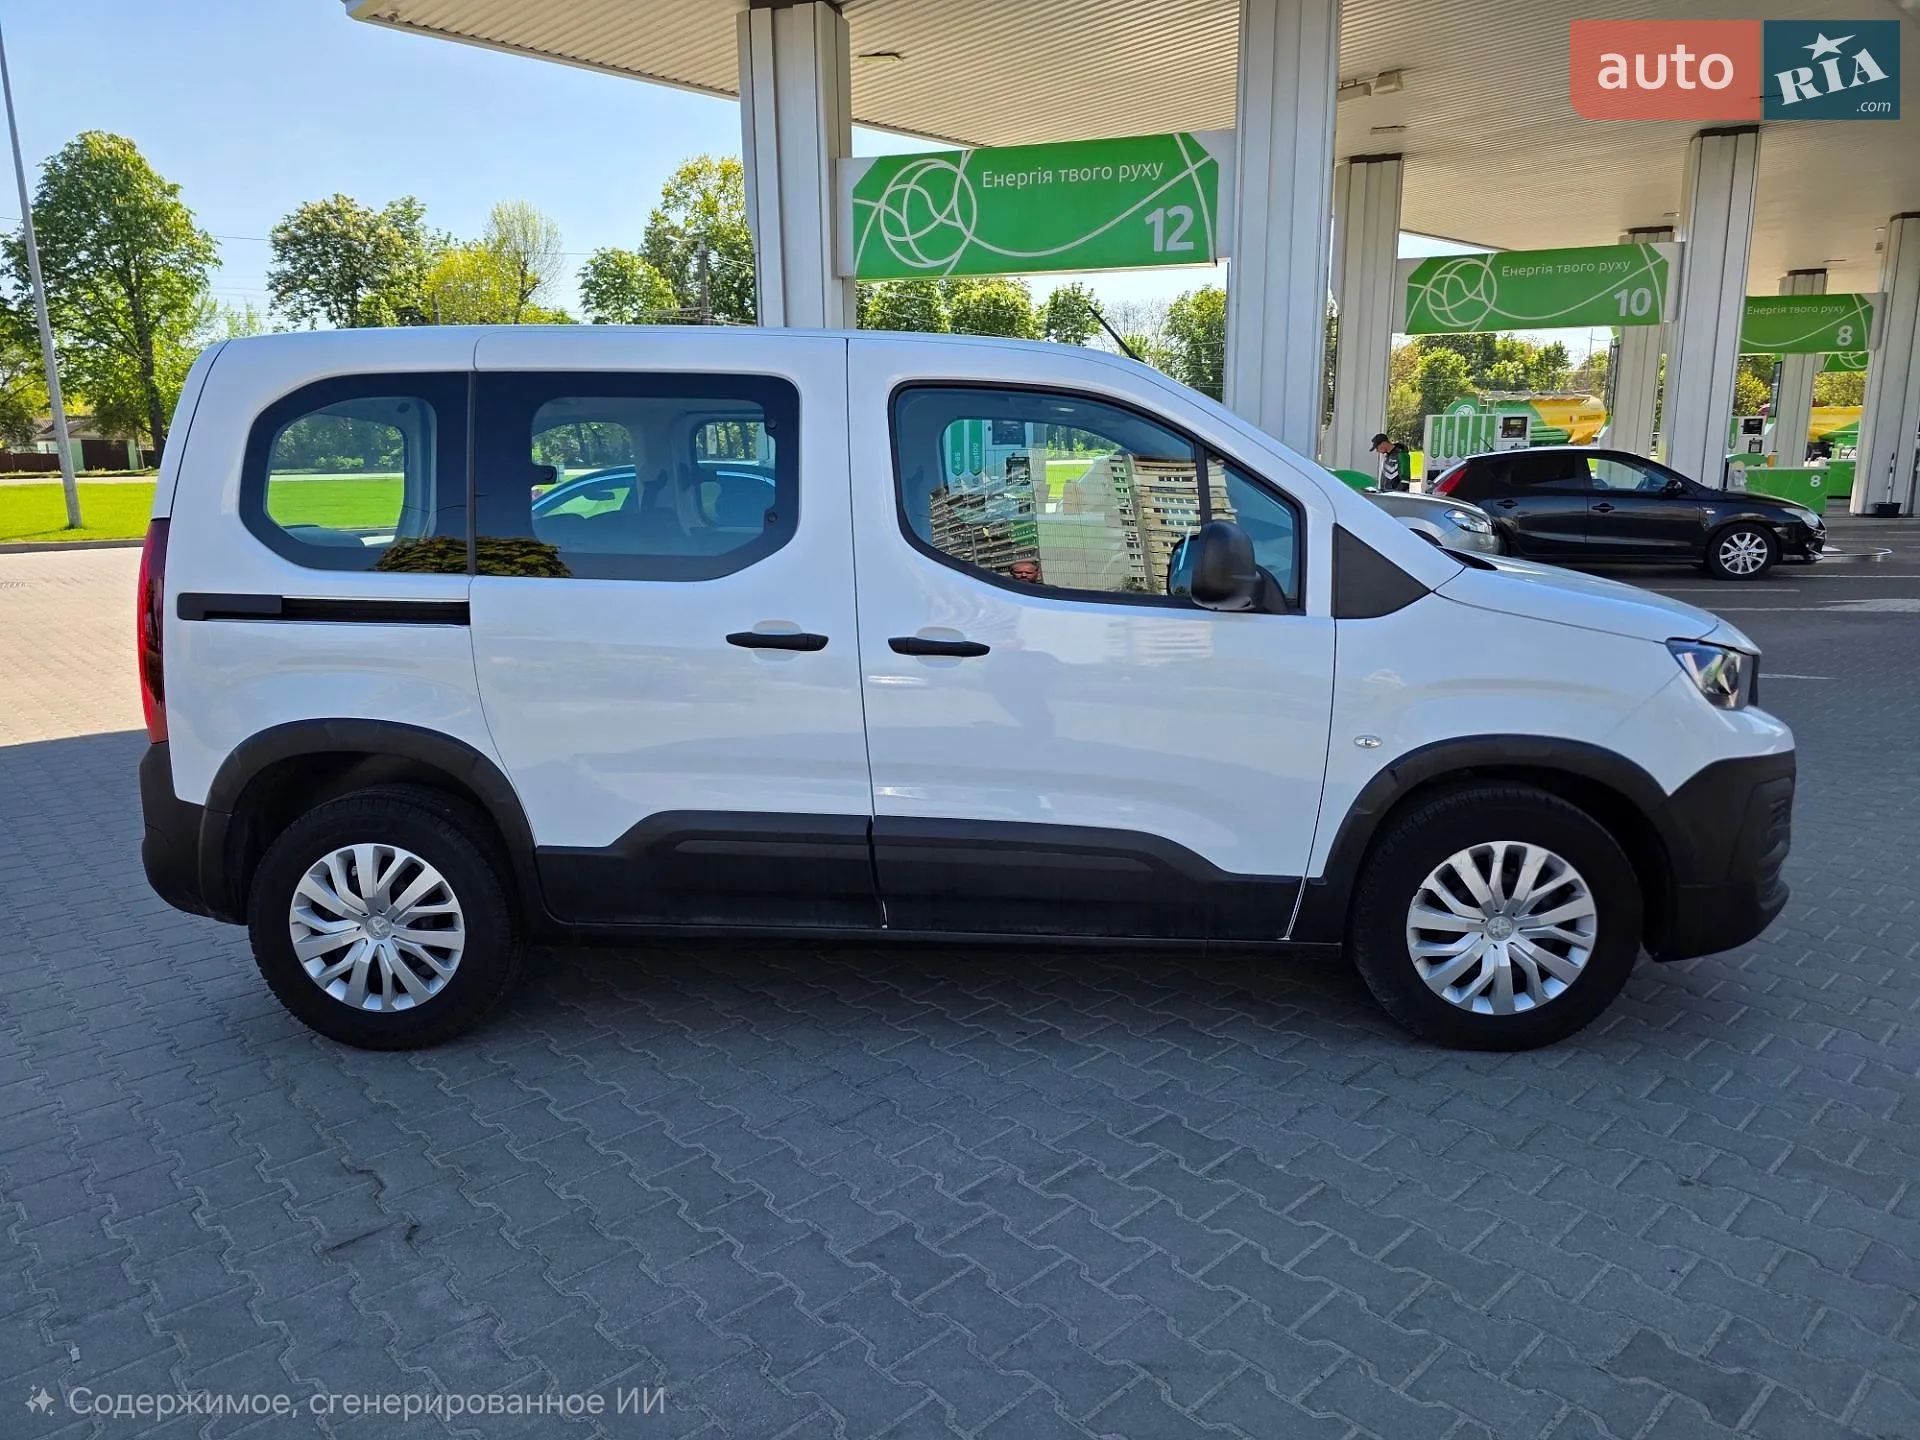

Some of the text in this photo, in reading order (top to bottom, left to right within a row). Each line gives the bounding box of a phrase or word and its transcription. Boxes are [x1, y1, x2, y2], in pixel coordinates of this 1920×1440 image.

[982, 160, 1164, 190] Енергія твого руху
[1144, 204, 1195, 253] 12
[1501, 260, 1632, 278] Енергія твого руху
[1613, 287, 1652, 317] 10
[1746, 304, 1845, 318] Енергія твого руху
[1836, 325, 1853, 346] 8
[1810, 475, 1821, 487] 8
